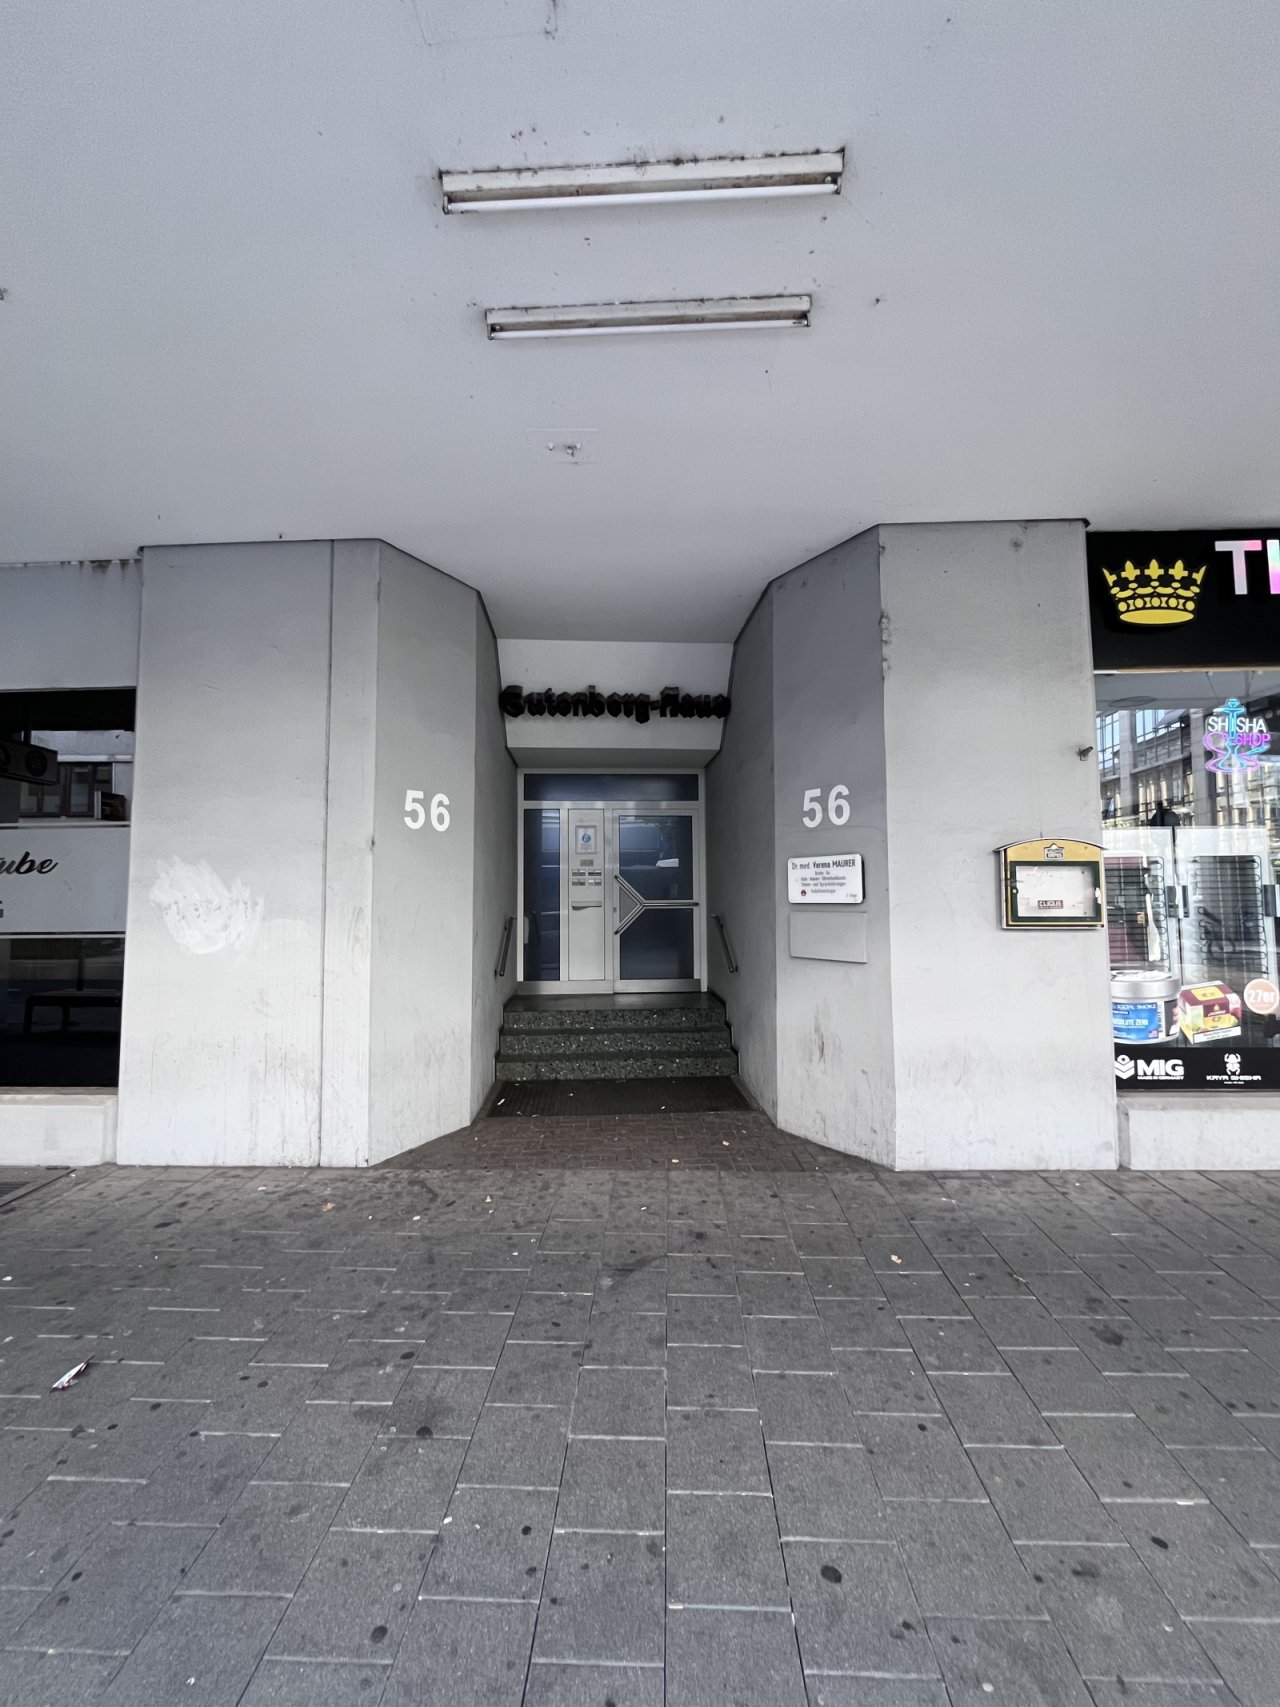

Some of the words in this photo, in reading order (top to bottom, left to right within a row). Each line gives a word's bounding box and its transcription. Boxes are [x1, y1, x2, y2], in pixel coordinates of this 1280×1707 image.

[1208, 717, 1267, 733] SHISHA
[1236, 732, 1271, 746] SHOP
[404, 789, 451, 832] 56
[803, 784, 851, 828] 56
[0, 851, 59, 875] ube
[832, 859, 856, 868] MAURER
[1137, 1059, 1185, 1076] MIG
